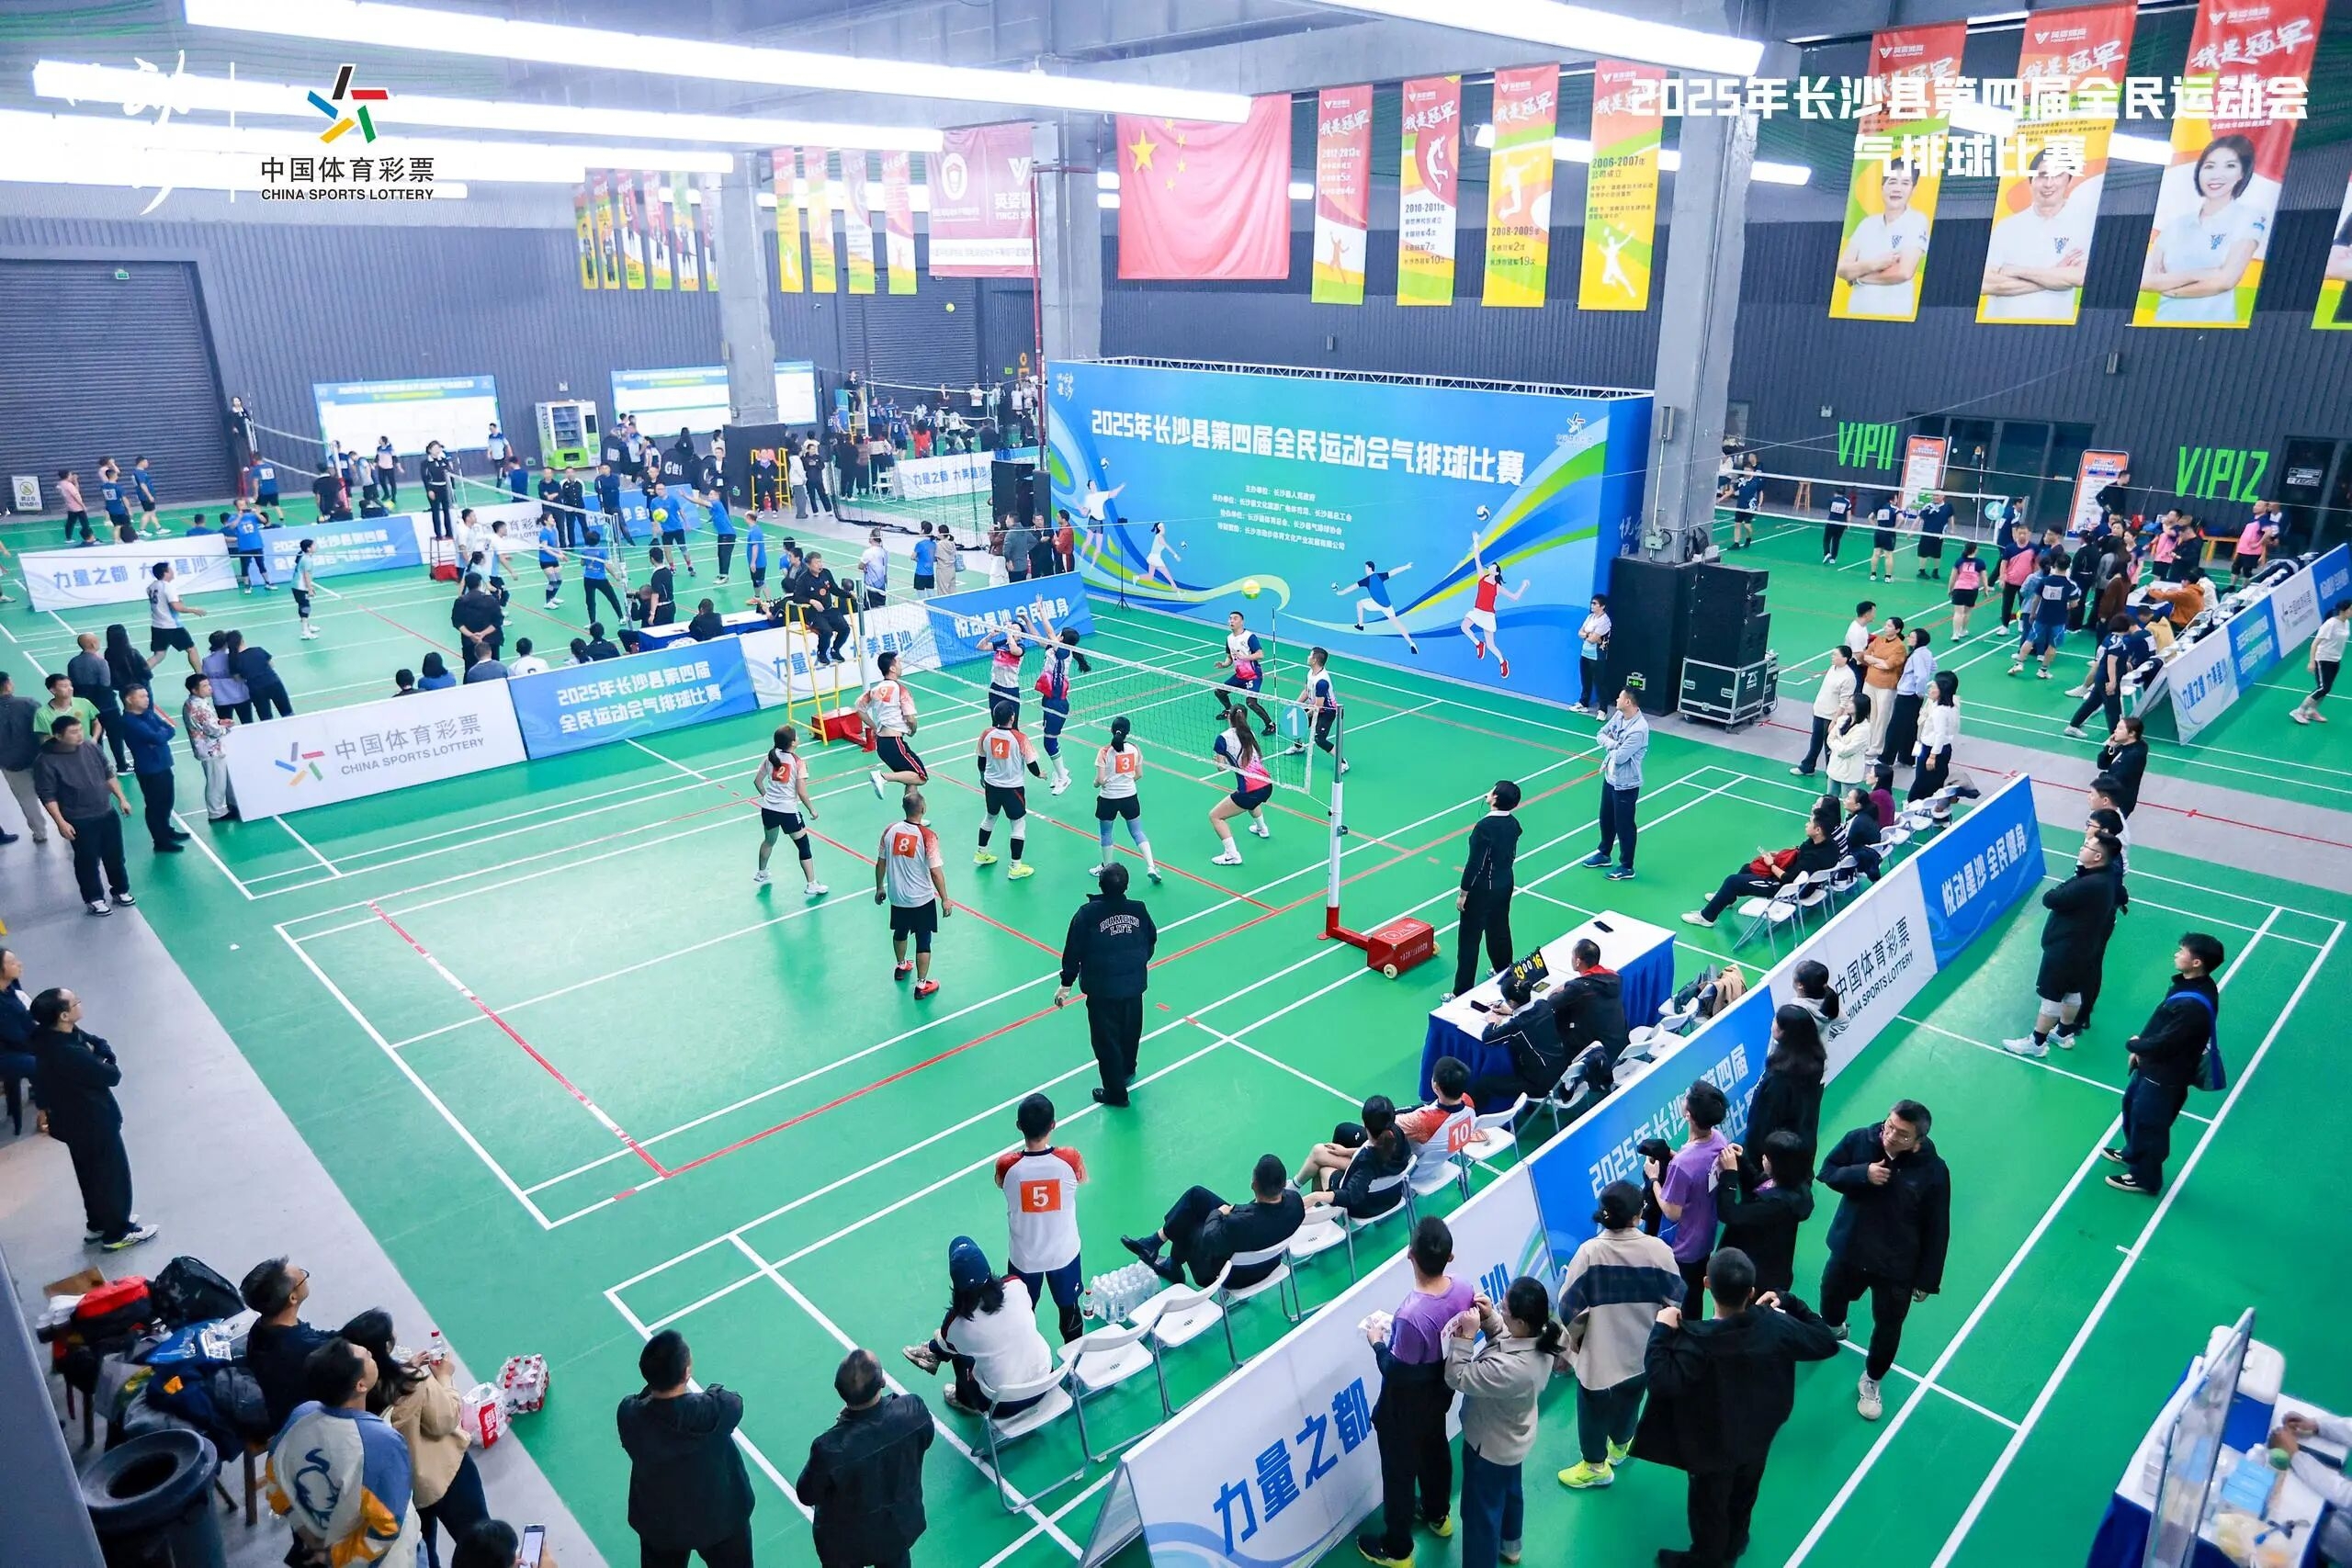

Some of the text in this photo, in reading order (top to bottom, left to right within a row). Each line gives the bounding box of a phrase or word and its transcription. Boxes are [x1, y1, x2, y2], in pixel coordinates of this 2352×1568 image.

[1091, 410, 1525, 487] 2025年长沙县第四届全民运动会气排球比赛
[1988, 502, 2001, 520] 4
[53, 565, 129, 590] 力量之都
[557, 660, 713, 706] 2025年长沙县第四届
[879, 687, 888, 698] 9
[560, 686, 722, 735] 全民运动会气排球比赛
[1286, 707, 1299, 736] 1
[334, 712, 483, 761] 中国体育彩票
[994, 742, 1003, 754] 4
[340, 737, 485, 776] CHINA SPORTS LOTTERY
[1121, 757, 1130, 769] 3
[776, 765, 786, 779] 2
[898, 838, 910, 852] 8
[1941, 823, 2028, 918] 悦动星沙 全民健身
[1100, 914, 1140, 932] DIAMOND
[1110, 924, 1133, 936] LIFE
[1835, 916, 1911, 1004] 中国体育彩票
[1846, 951, 1914, 1021] HINA SPORTS LOTTERY
[1452, 1122, 1469, 1146] 10
[1033, 1186, 1049, 1207] 5
[1213, 1376, 1373, 1557] 力量之都
